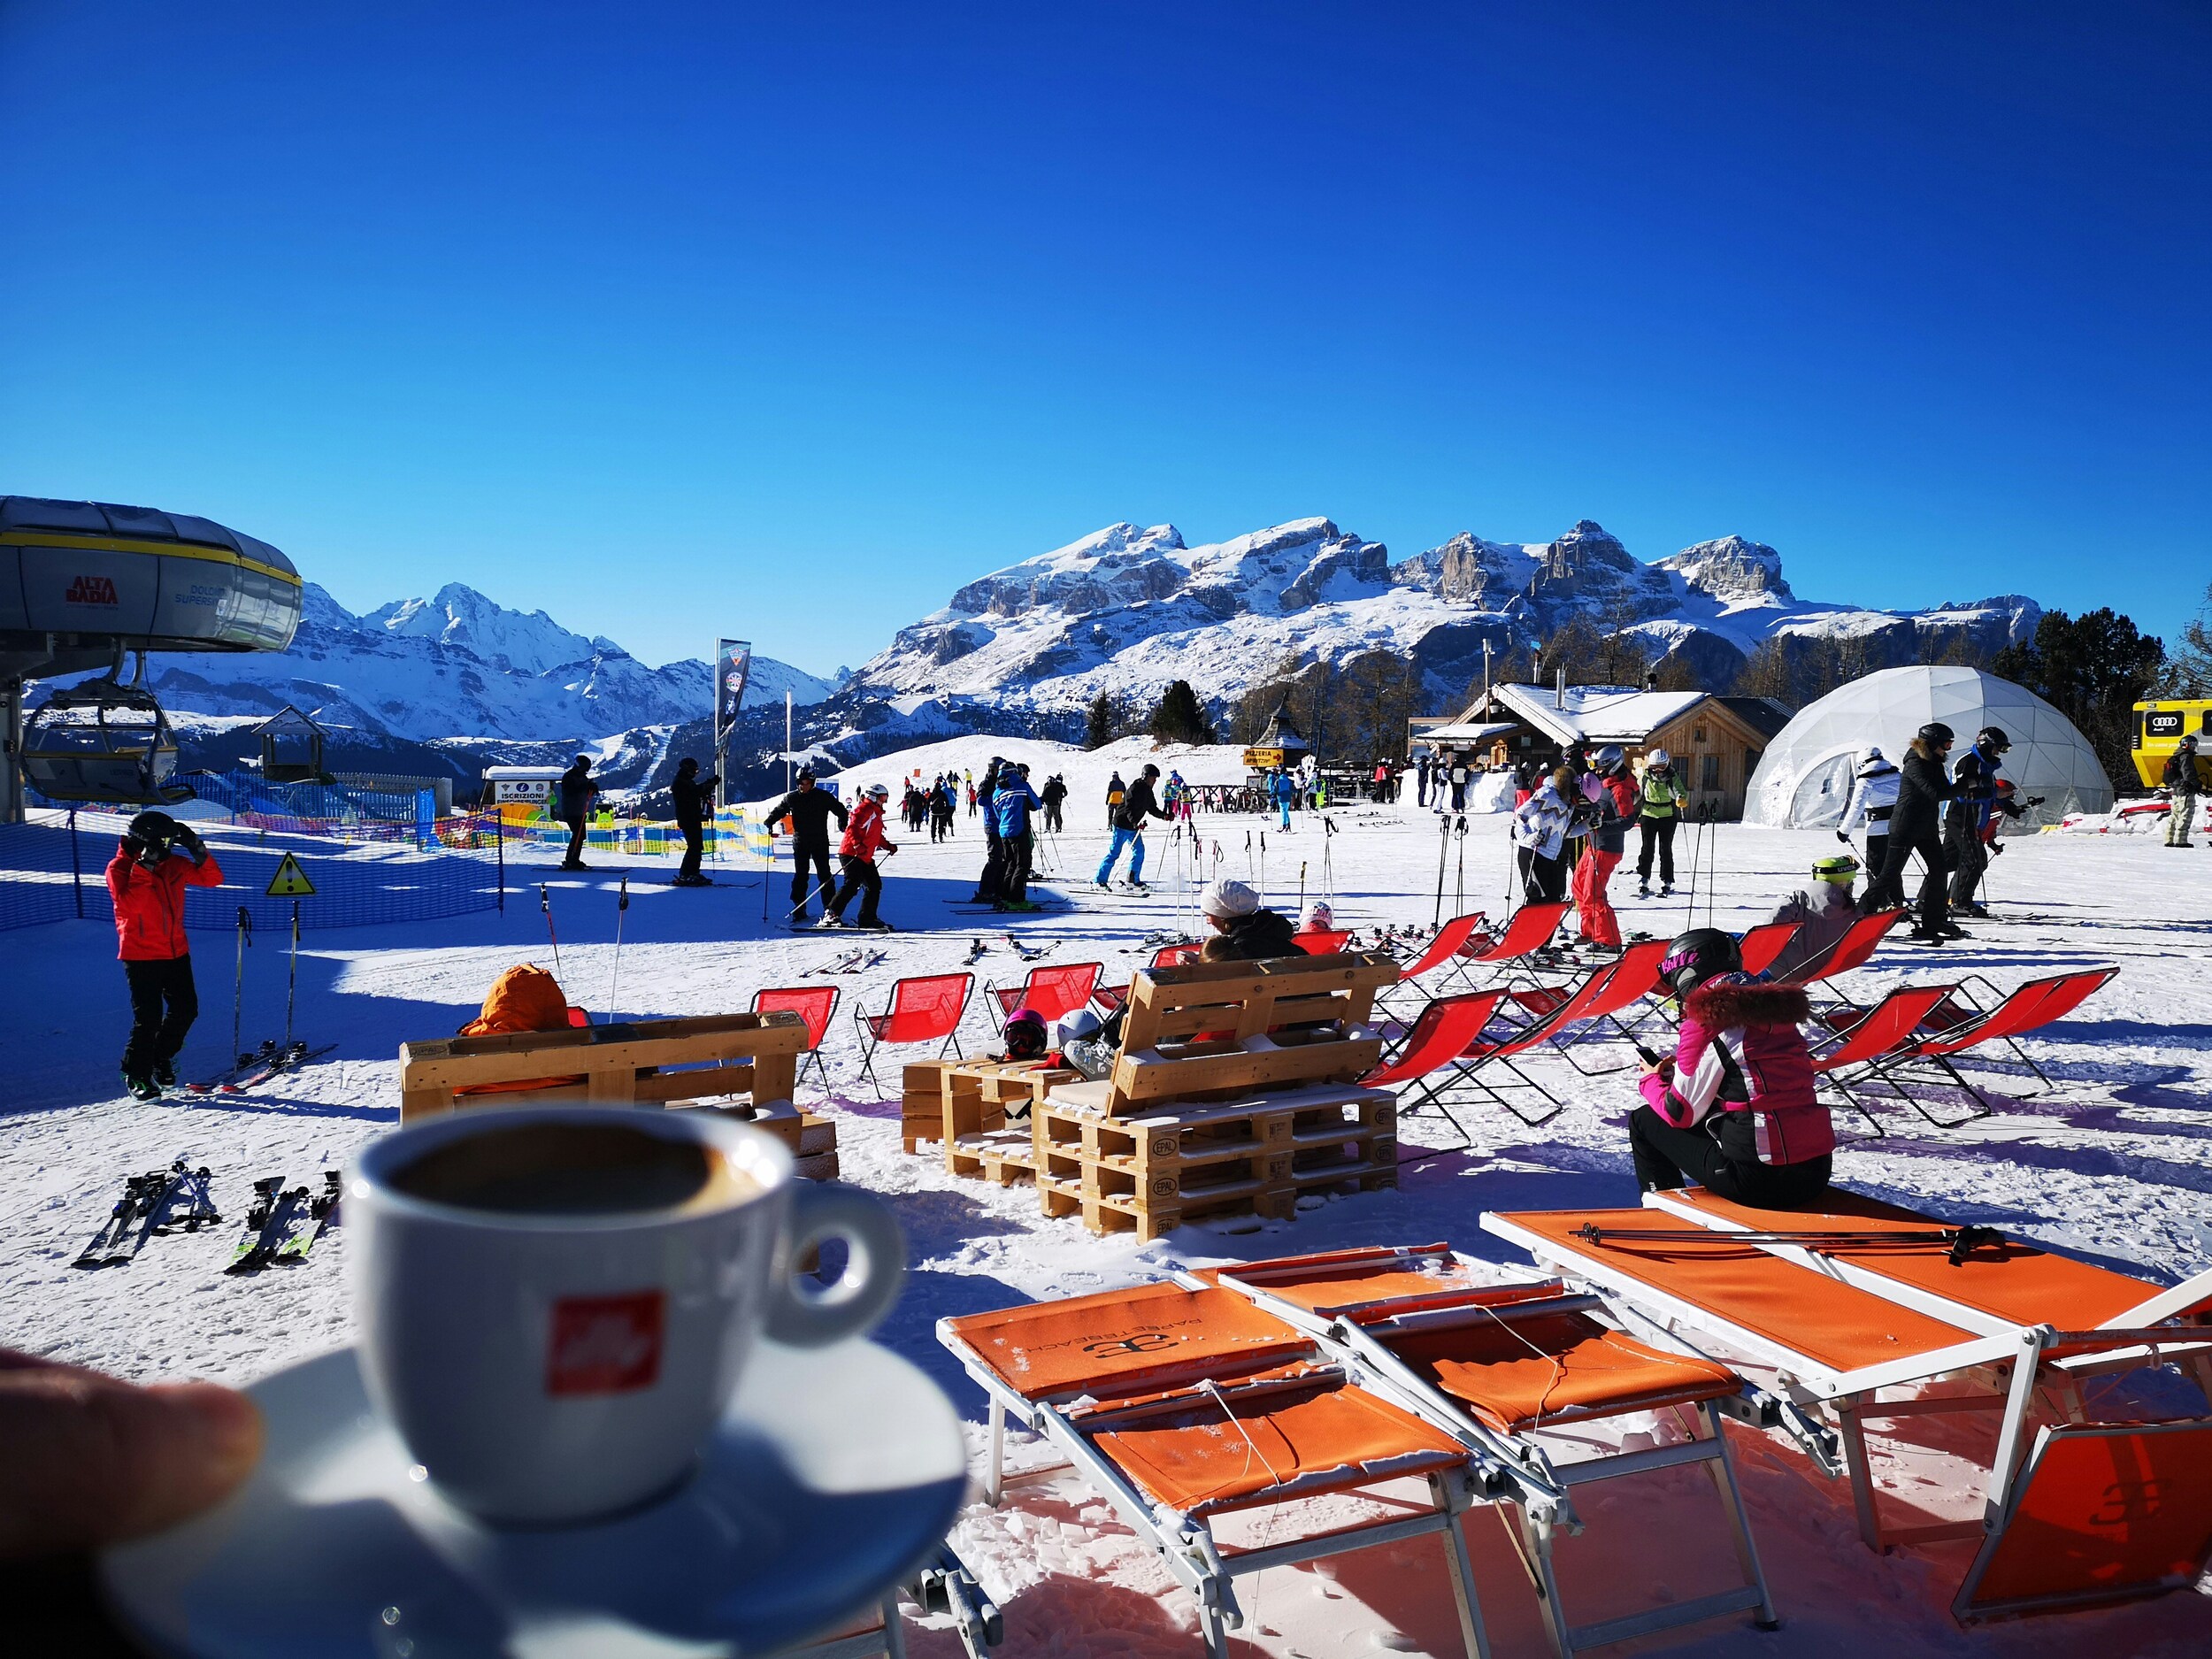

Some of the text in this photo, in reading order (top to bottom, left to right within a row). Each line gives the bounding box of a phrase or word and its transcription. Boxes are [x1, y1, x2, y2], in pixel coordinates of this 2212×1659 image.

[73, 576, 114, 591] ALTA
[66, 588, 118, 603] BADIA
[1156, 1141, 1175, 1153] EPAL
[1156, 1180, 1175, 1193] EPAL
